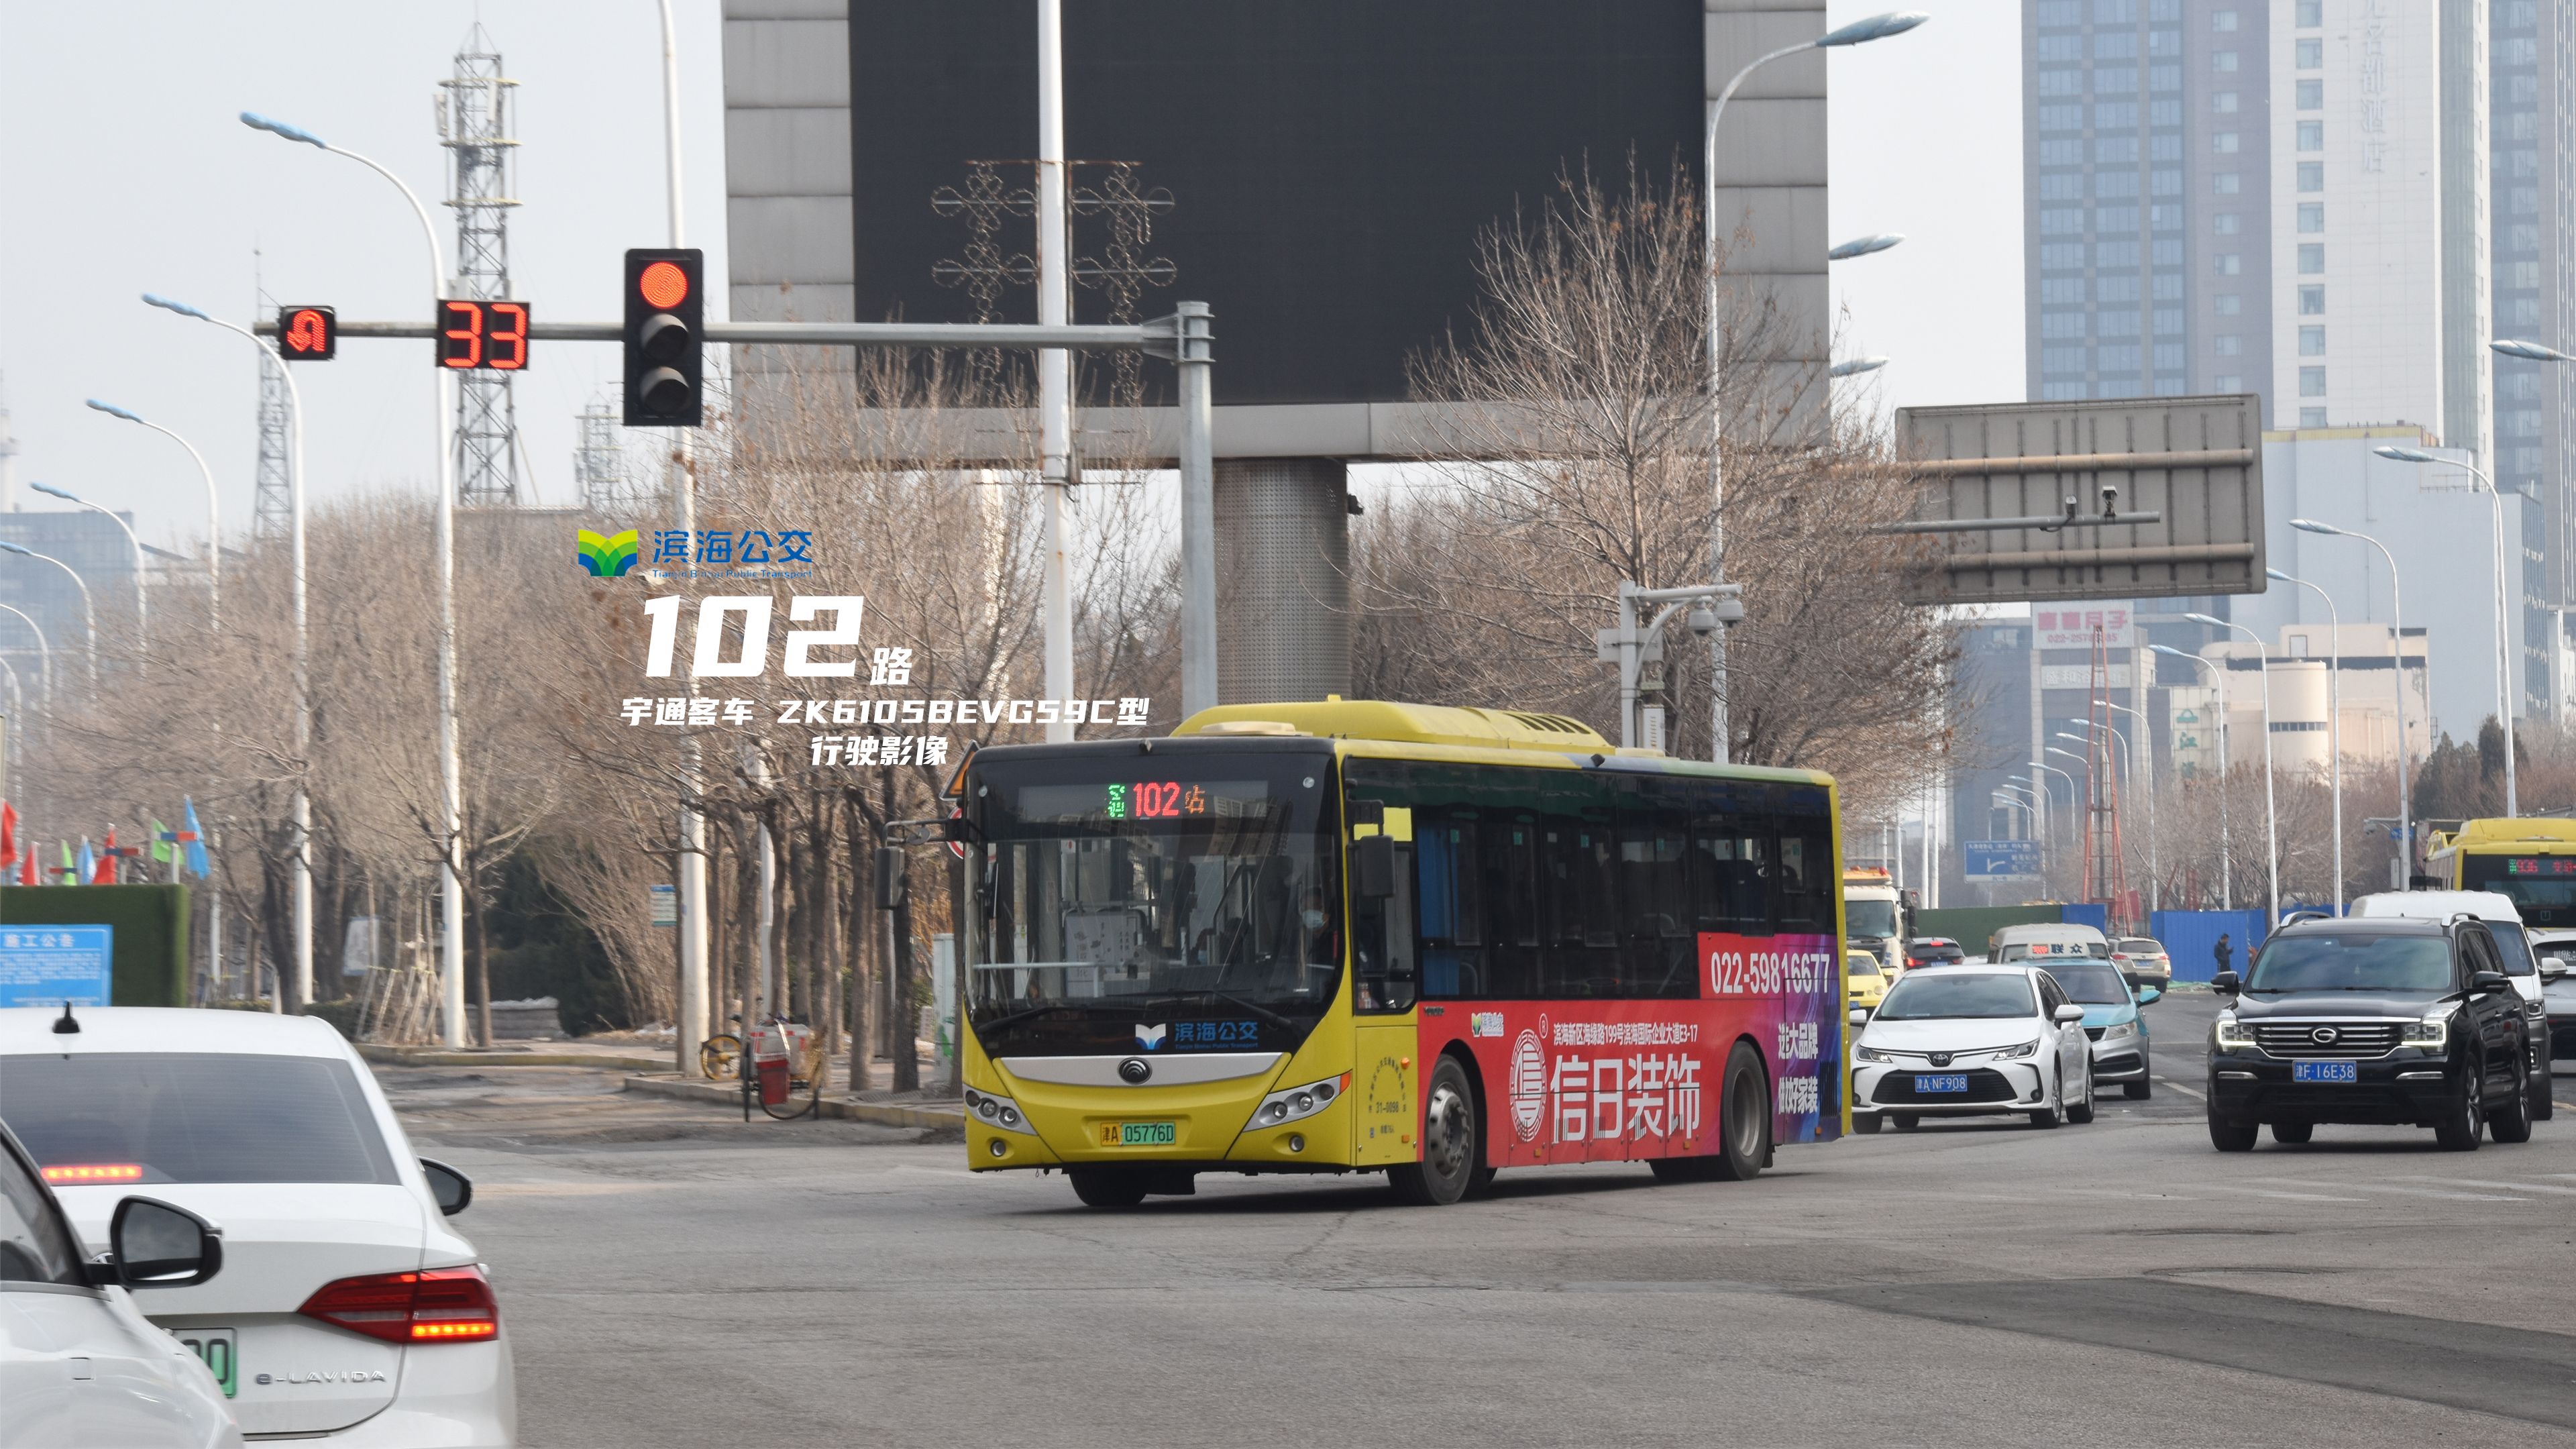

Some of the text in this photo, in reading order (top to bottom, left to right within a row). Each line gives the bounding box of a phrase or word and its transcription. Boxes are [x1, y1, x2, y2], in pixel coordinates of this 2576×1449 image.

[444, 301, 527, 368] 33
[1134, 782, 1180, 817] 102
[1711, 951, 1830, 994] 022-59816677
[1175, 1021, 1258, 1042] 滨海公交
[1778, 1022, 1818, 1059] 选大品牌
[1550, 1053, 1701, 1144] 信日装饰
[256, 1371, 386, 1385] e-LAVIDA
